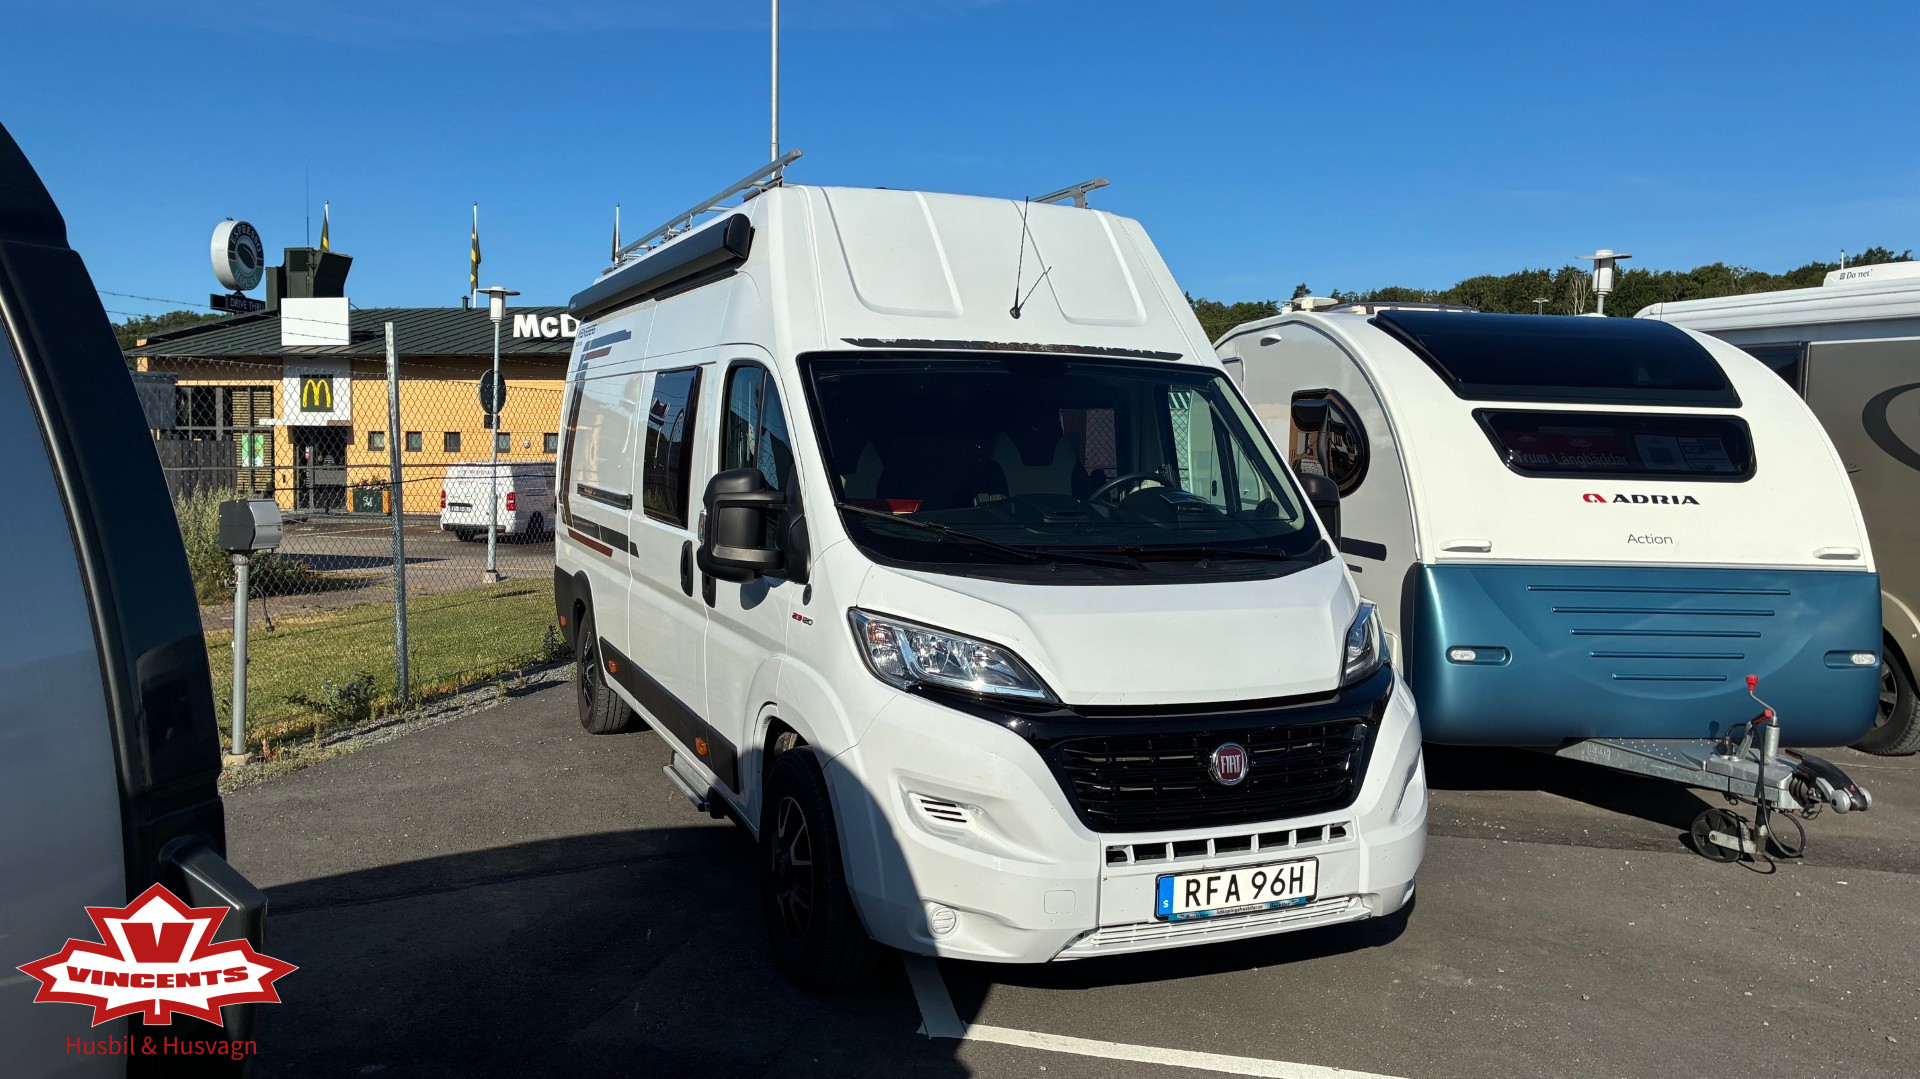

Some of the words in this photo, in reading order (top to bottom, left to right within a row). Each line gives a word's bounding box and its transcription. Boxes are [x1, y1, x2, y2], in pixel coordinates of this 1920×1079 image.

[231, 225, 262, 251] ESPRESSO
[234, 269, 259, 287] HOUSE
[230, 298, 247, 310] DRIVE
[1612, 493, 1700, 506] ADRIA
[1627, 533, 1673, 545] Action
[1220, 754, 1241, 774] FIAT
[1185, 874, 1241, 908] RFA
[1251, 865, 1304, 900] 96H
[1162, 899, 1169, 908] S
